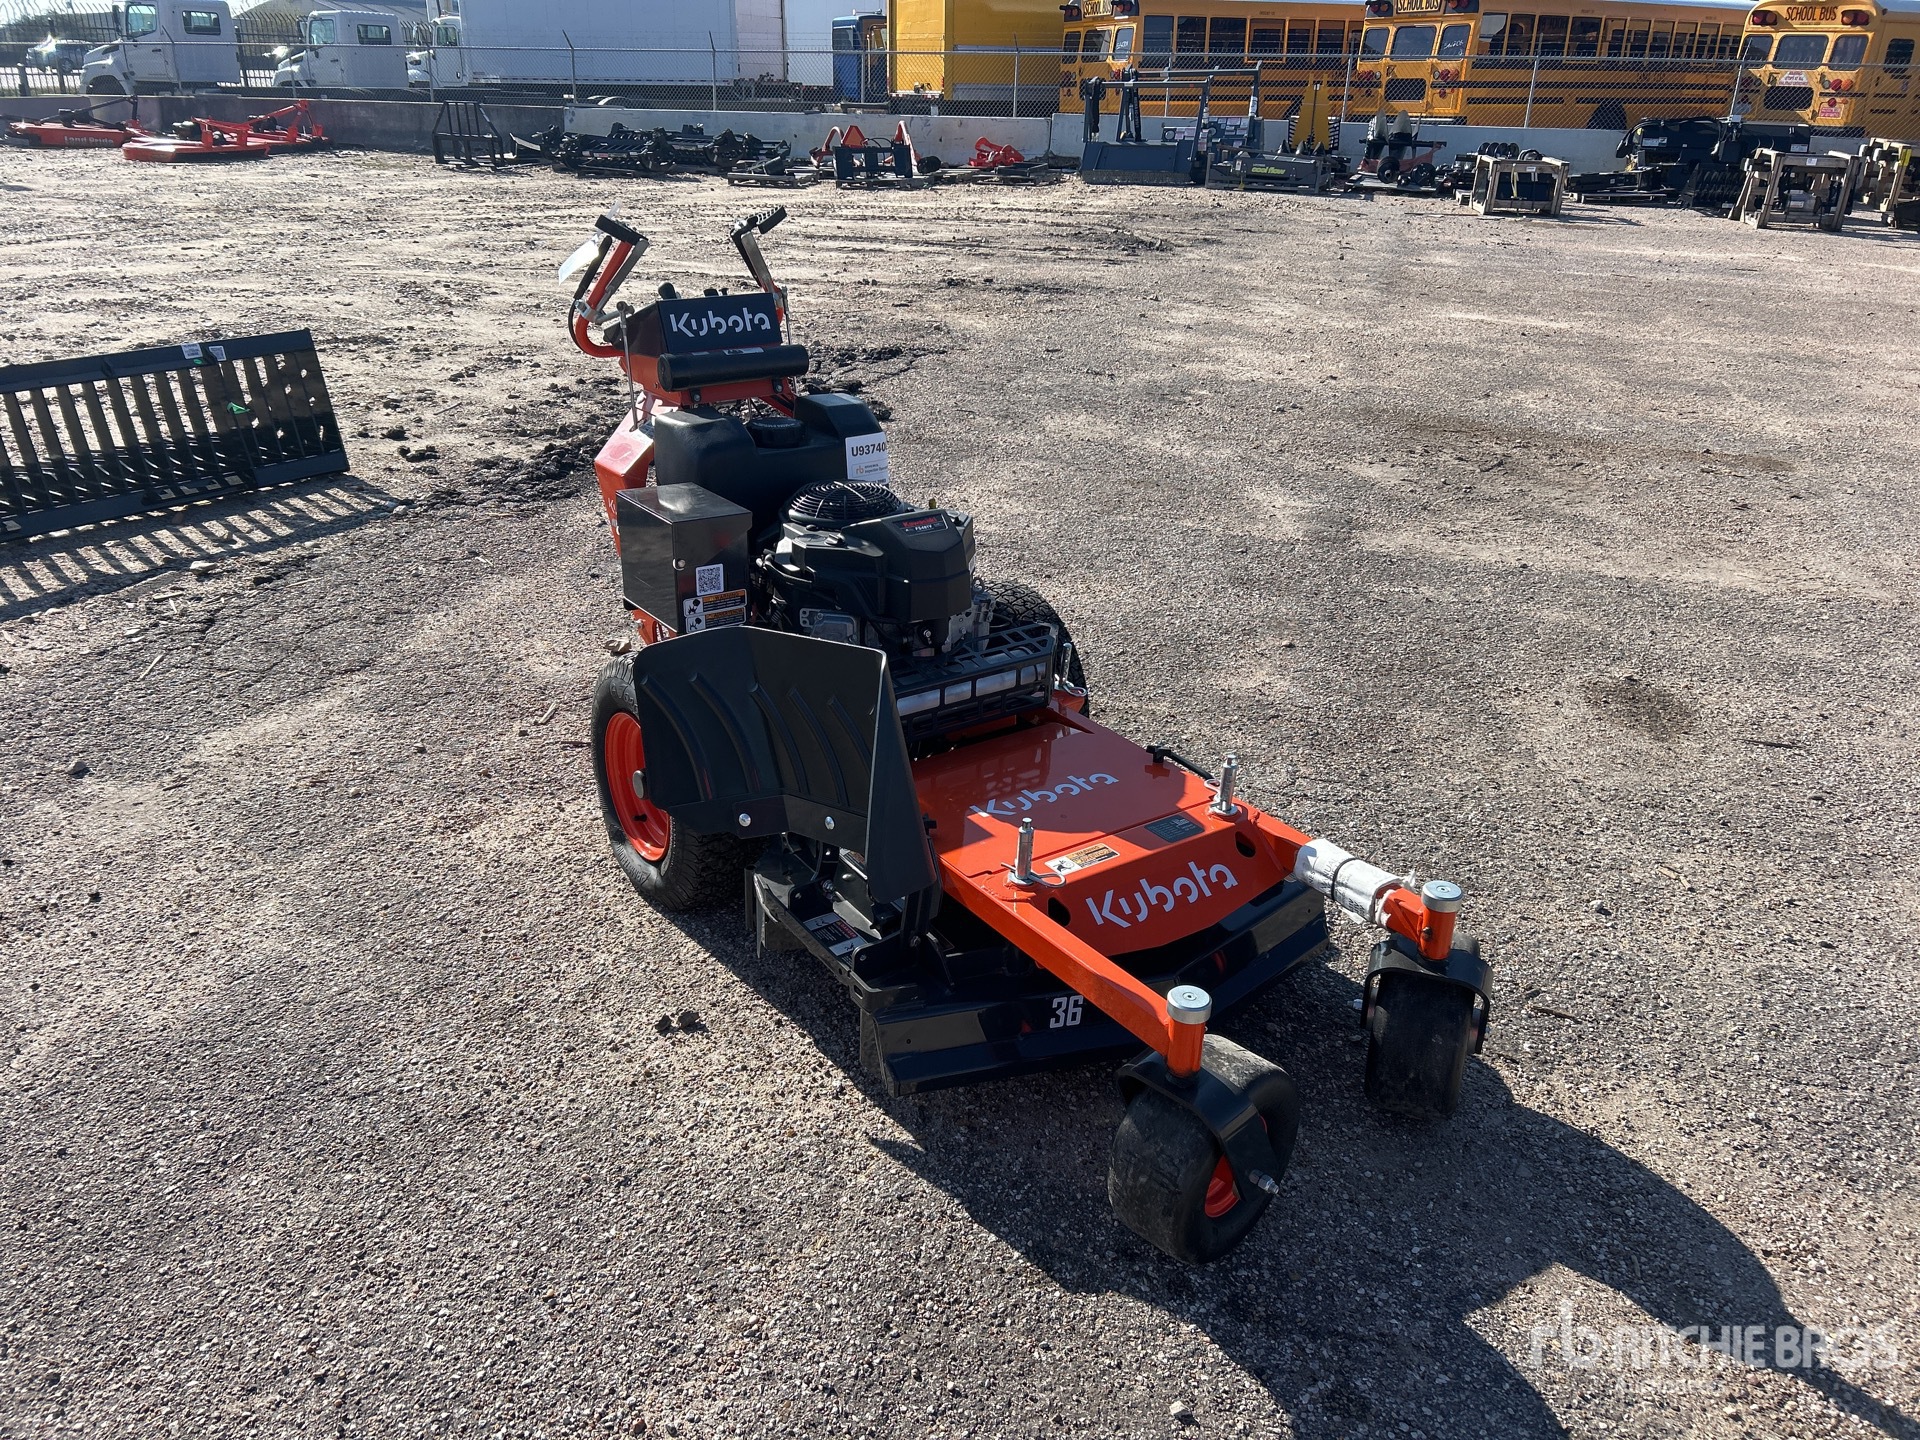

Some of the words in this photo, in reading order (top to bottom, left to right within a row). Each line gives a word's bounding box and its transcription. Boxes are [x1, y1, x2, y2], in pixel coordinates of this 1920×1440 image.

[1398, 0, 1424, 11] SCHOOL
[1425, 0, 1438, 10] BUS
[1785, 6, 1816, 21] SCHOOL
[1819, 6, 1838, 20] BUS
[64, 135, 87, 144] Land
[669, 307, 771, 338] Kubota
[970, 772, 1119, 817] Kubota
[1086, 861, 1238, 928] Kubota
[1050, 995, 1084, 1028] 36
